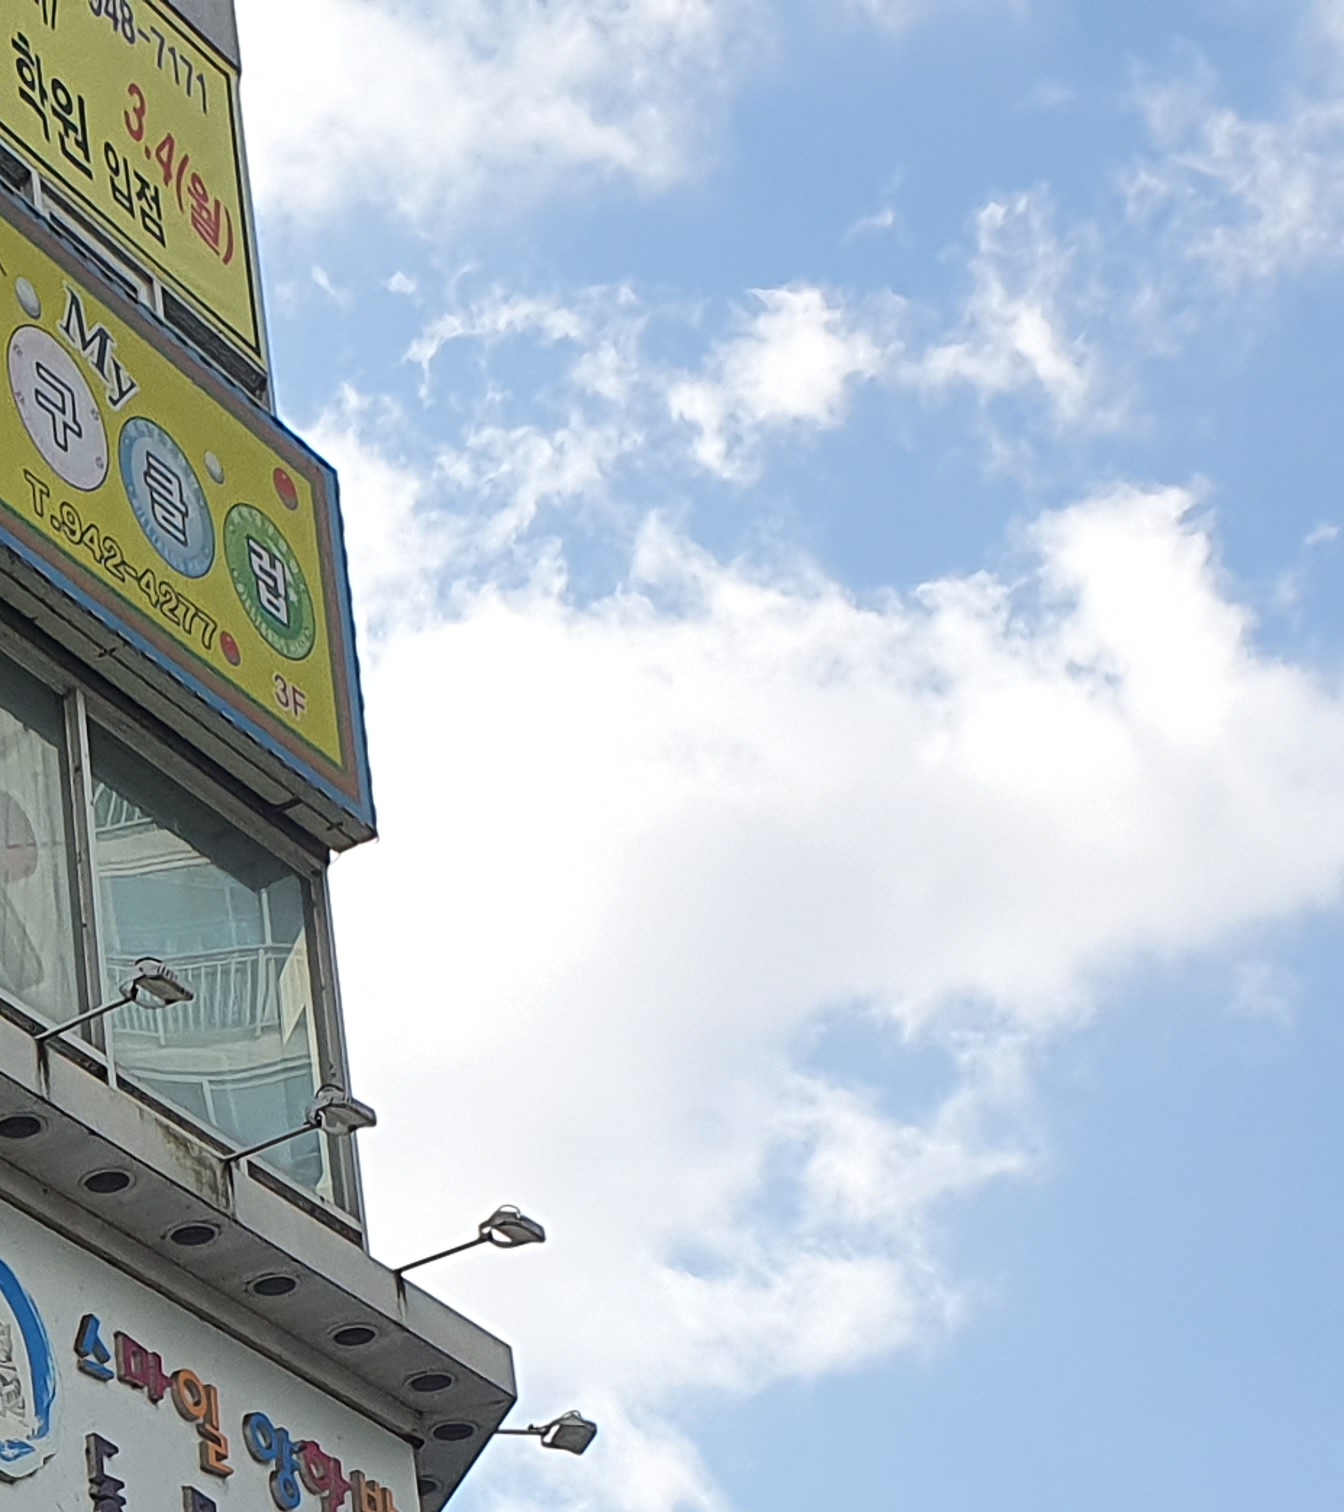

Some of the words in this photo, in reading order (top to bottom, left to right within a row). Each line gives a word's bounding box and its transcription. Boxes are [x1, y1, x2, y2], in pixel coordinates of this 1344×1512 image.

[11, 31, 95, 182] 학원
[103, 140, 167, 250] 입점
[123, 82, 235, 267] 3.4(월)
[60, 284, 138, 408] My
[273, 673, 308, 718] 3F
[73, 1312, 234, 1479] 스마일
